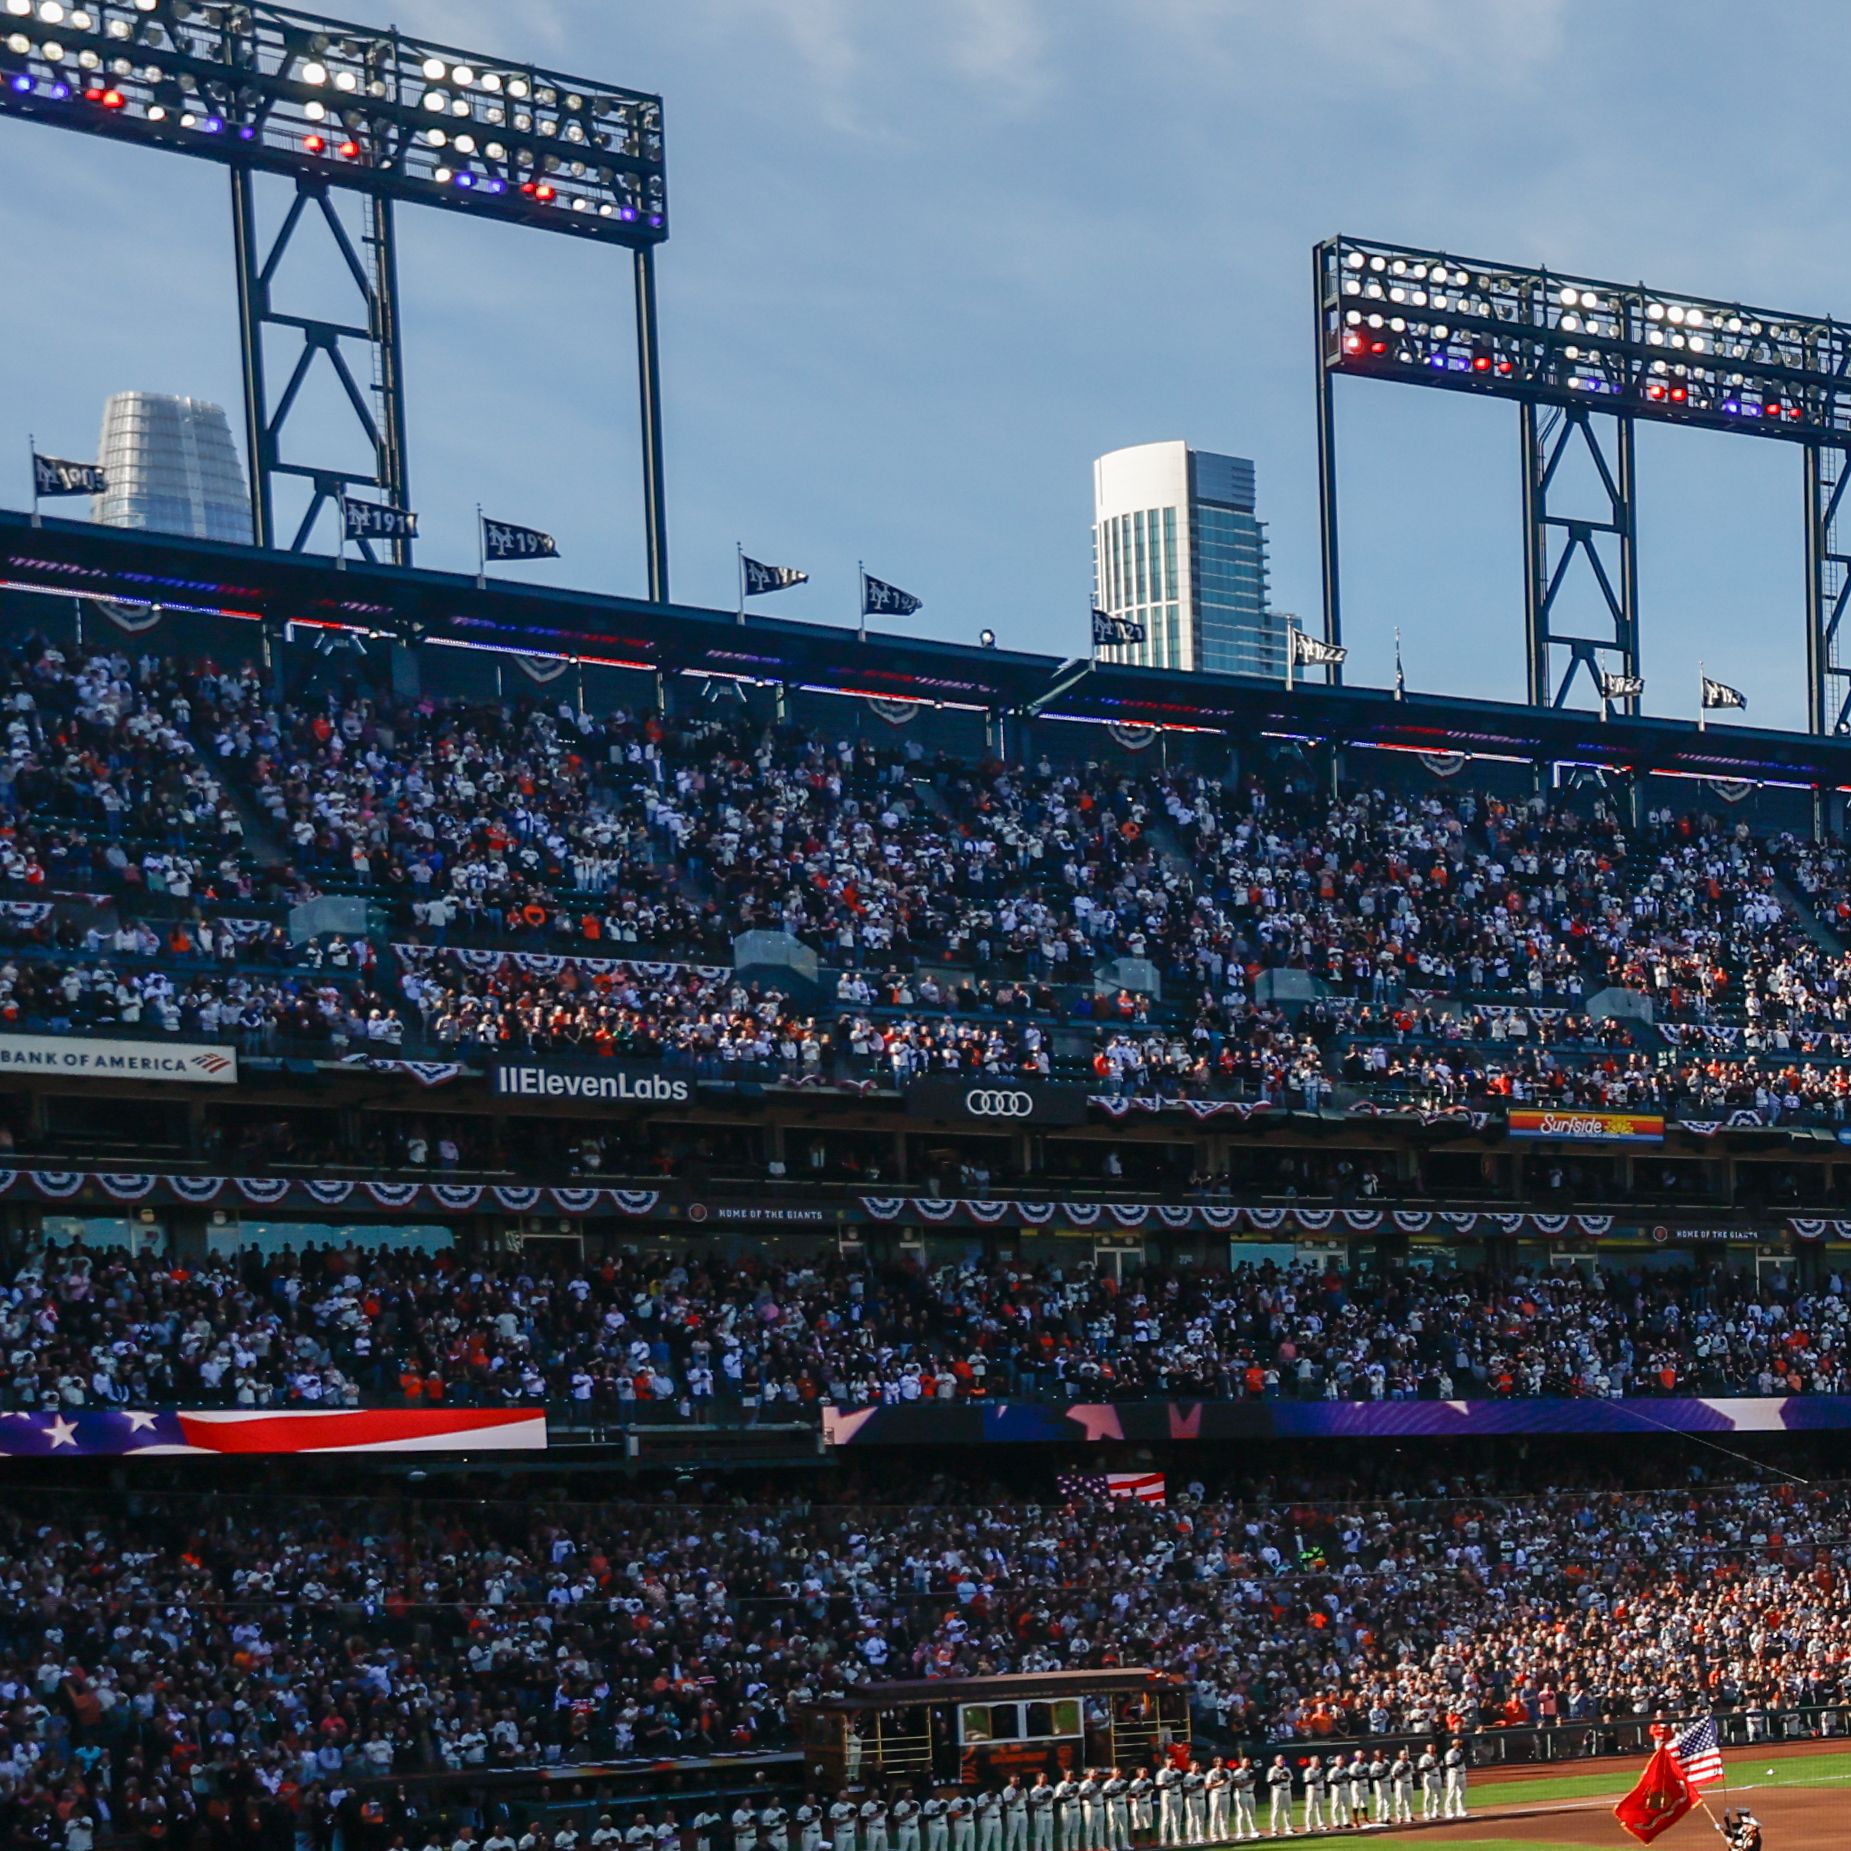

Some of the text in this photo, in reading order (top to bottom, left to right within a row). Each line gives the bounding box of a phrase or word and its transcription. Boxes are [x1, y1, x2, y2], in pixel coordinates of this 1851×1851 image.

[0, 1051, 187, 1072] BANK OF AMERICA
[1540, 1113, 1603, 1135] Surfside
[718, 1208, 823, 1220] HOME OF THE GIANTS
[1676, 1230, 1699, 1239] HOME
[1700, 1230, 1710, 1239] OF
[1712, 1231, 1728, 1239] THE
